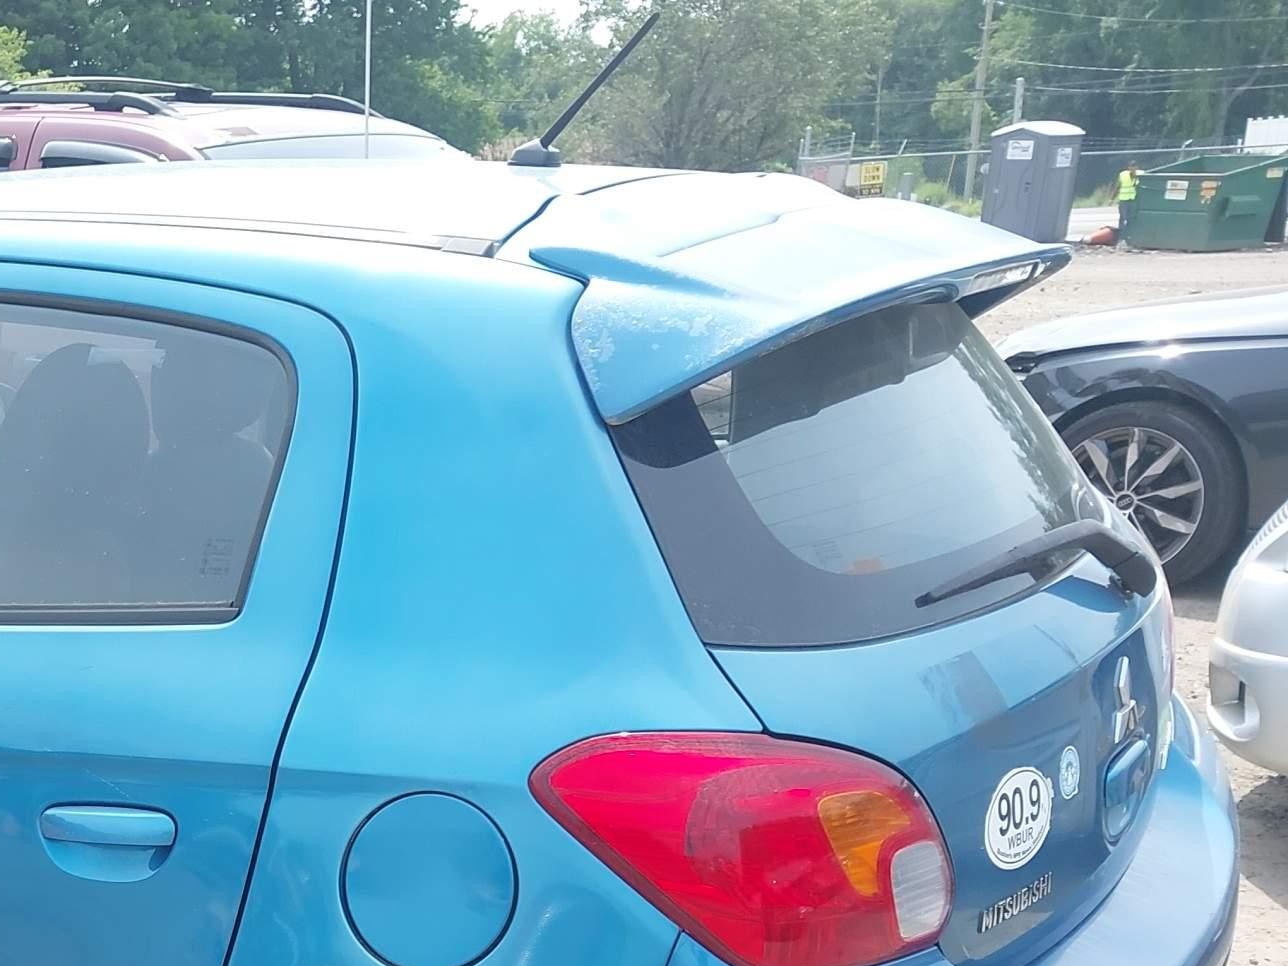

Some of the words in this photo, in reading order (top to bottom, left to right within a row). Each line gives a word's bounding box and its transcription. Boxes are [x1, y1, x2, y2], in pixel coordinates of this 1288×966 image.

[998, 778, 1041, 836] 90.9
[1007, 827, 1034, 850] WBUR
[978, 872, 1052, 933] MITSUBISHI
